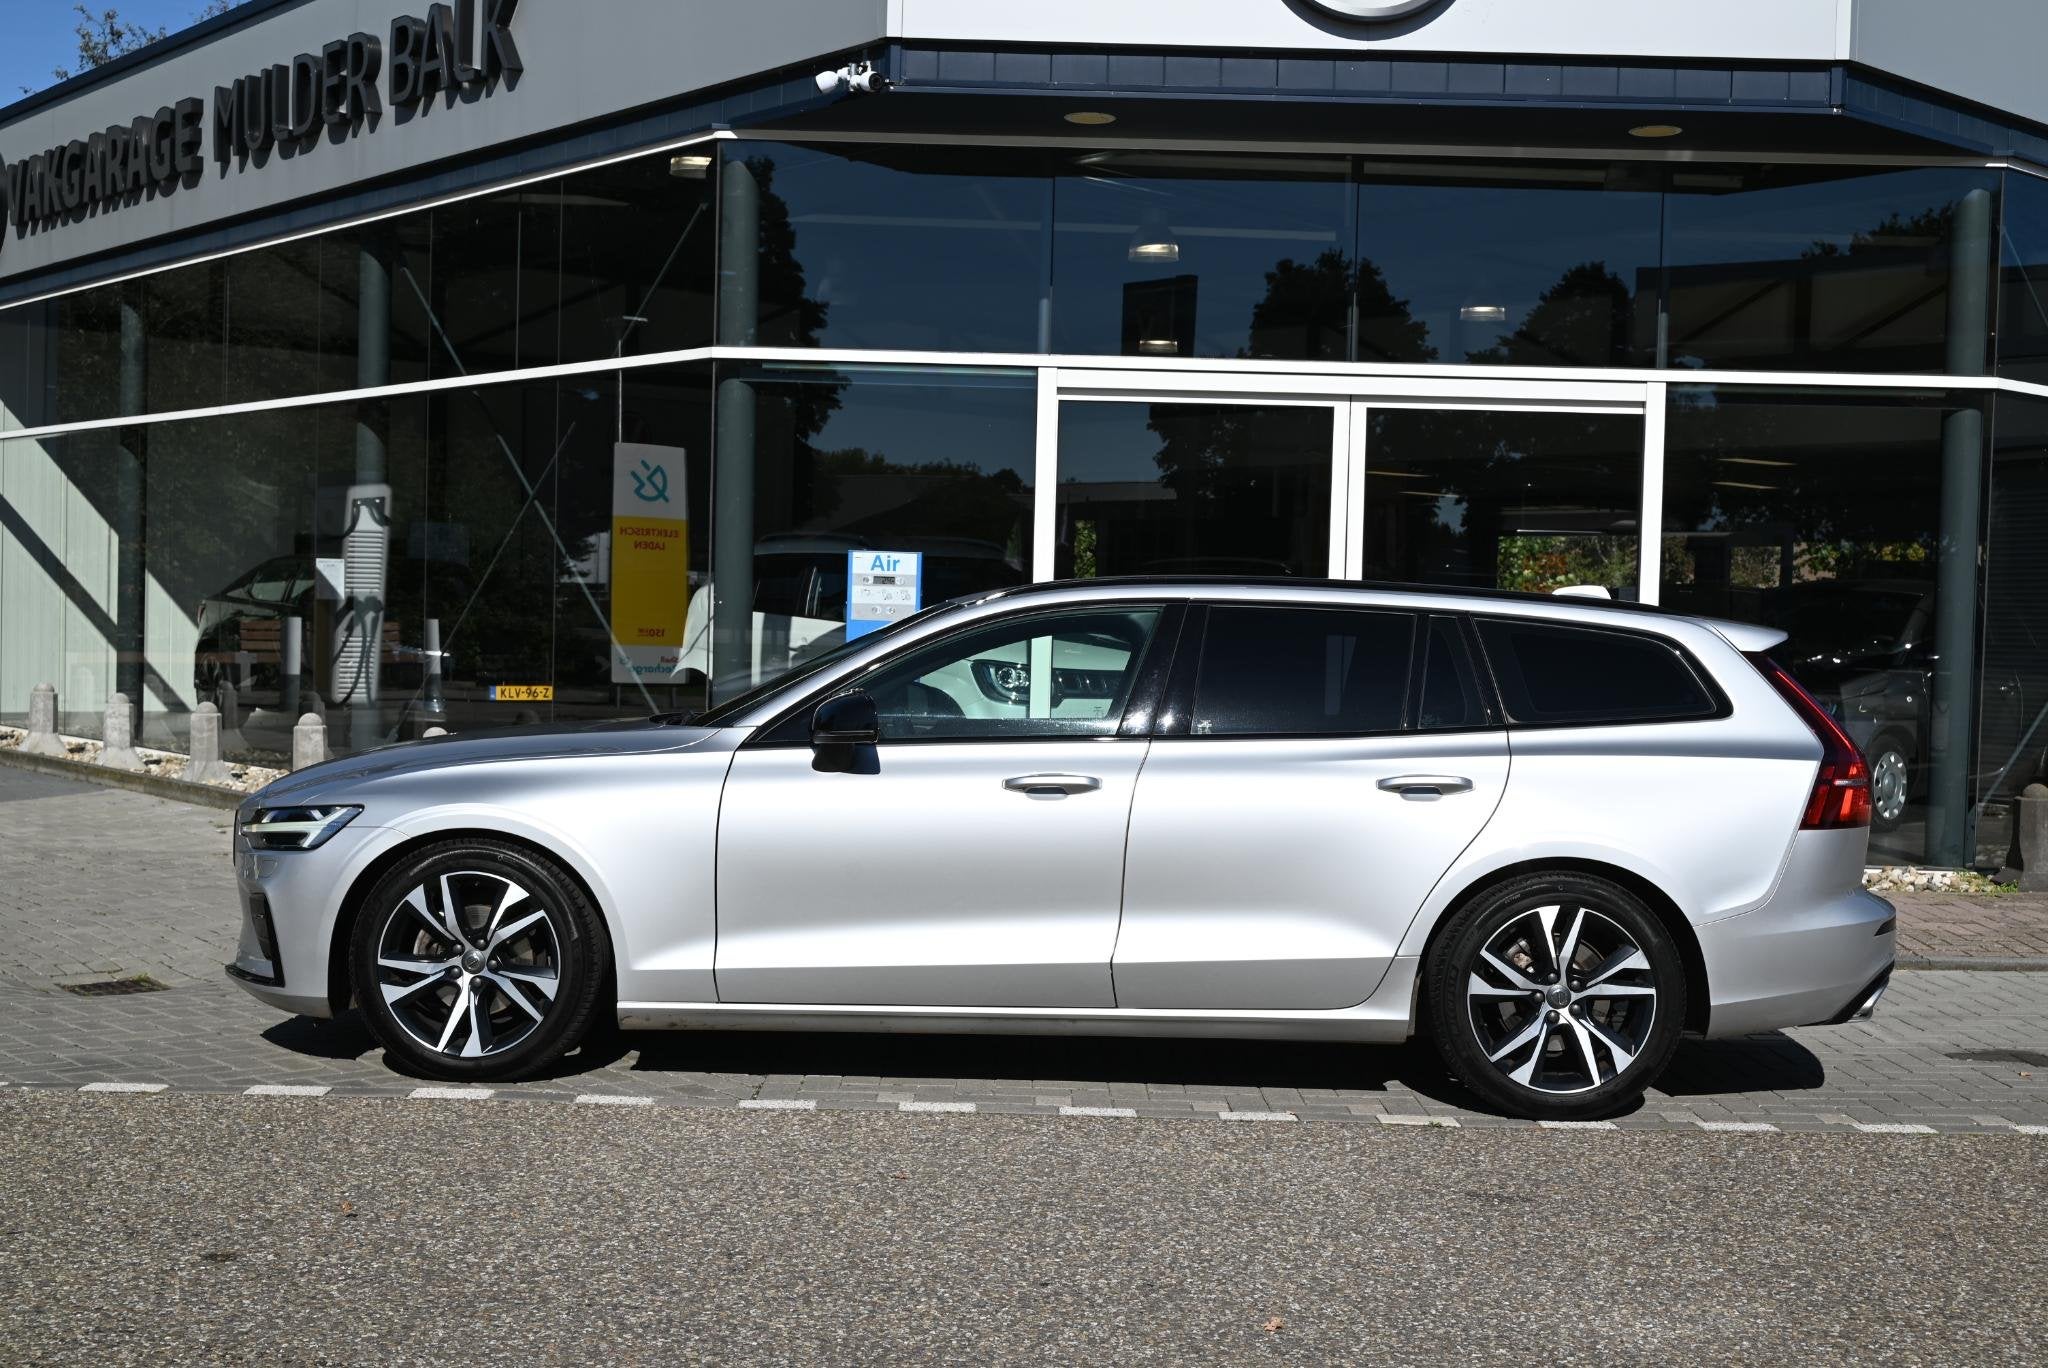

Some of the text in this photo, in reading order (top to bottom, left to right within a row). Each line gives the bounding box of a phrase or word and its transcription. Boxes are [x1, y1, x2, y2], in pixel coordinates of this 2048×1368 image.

[7, 0, 523, 227] VAKGARAGE MULDER BALK
[870, 554, 900, 572] Air
[500, 687, 550, 699] KLV-96-Z
